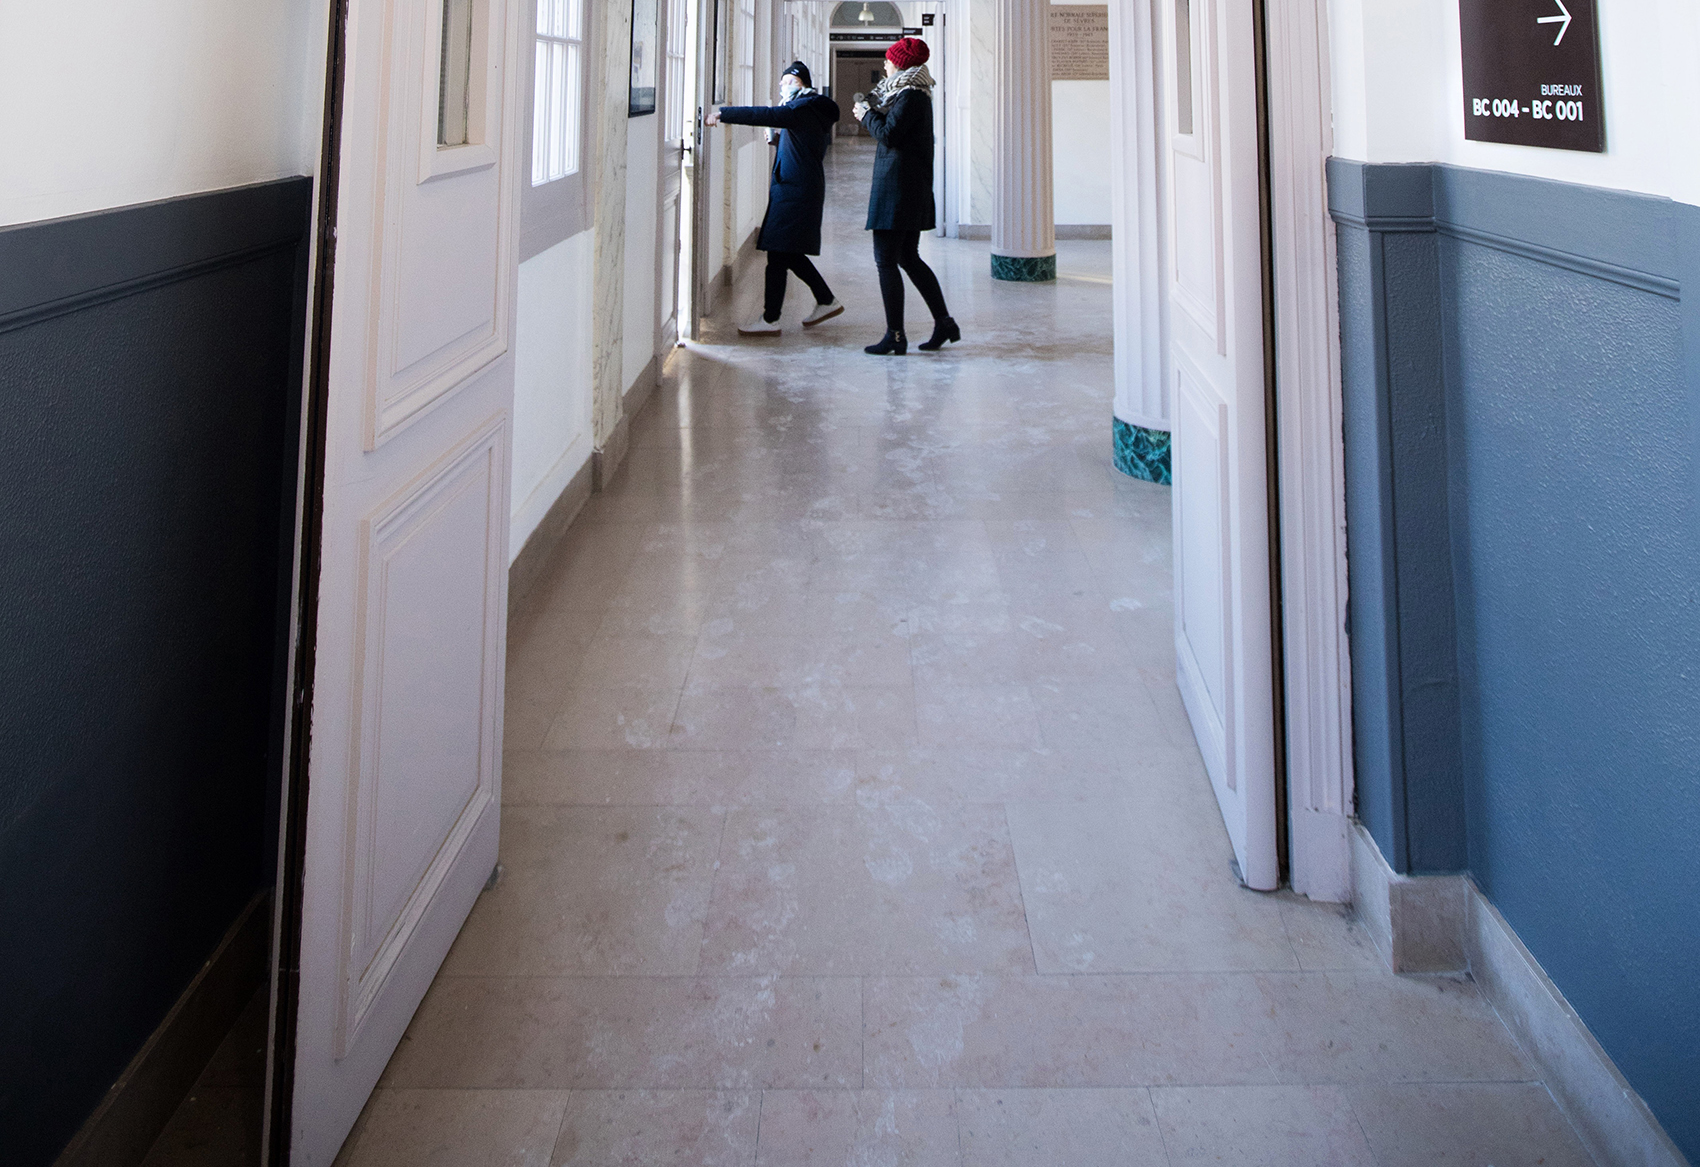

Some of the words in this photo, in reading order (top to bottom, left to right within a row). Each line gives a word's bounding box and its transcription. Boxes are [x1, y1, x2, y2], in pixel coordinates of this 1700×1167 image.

[1540, 84, 1583, 96] BUREAUX
[1472, 98, 1490, 116] BC
[1492, 98, 1519, 118] 004
[1532, 100, 1553, 120] BC
[1555, 100, 1584, 121] 001
